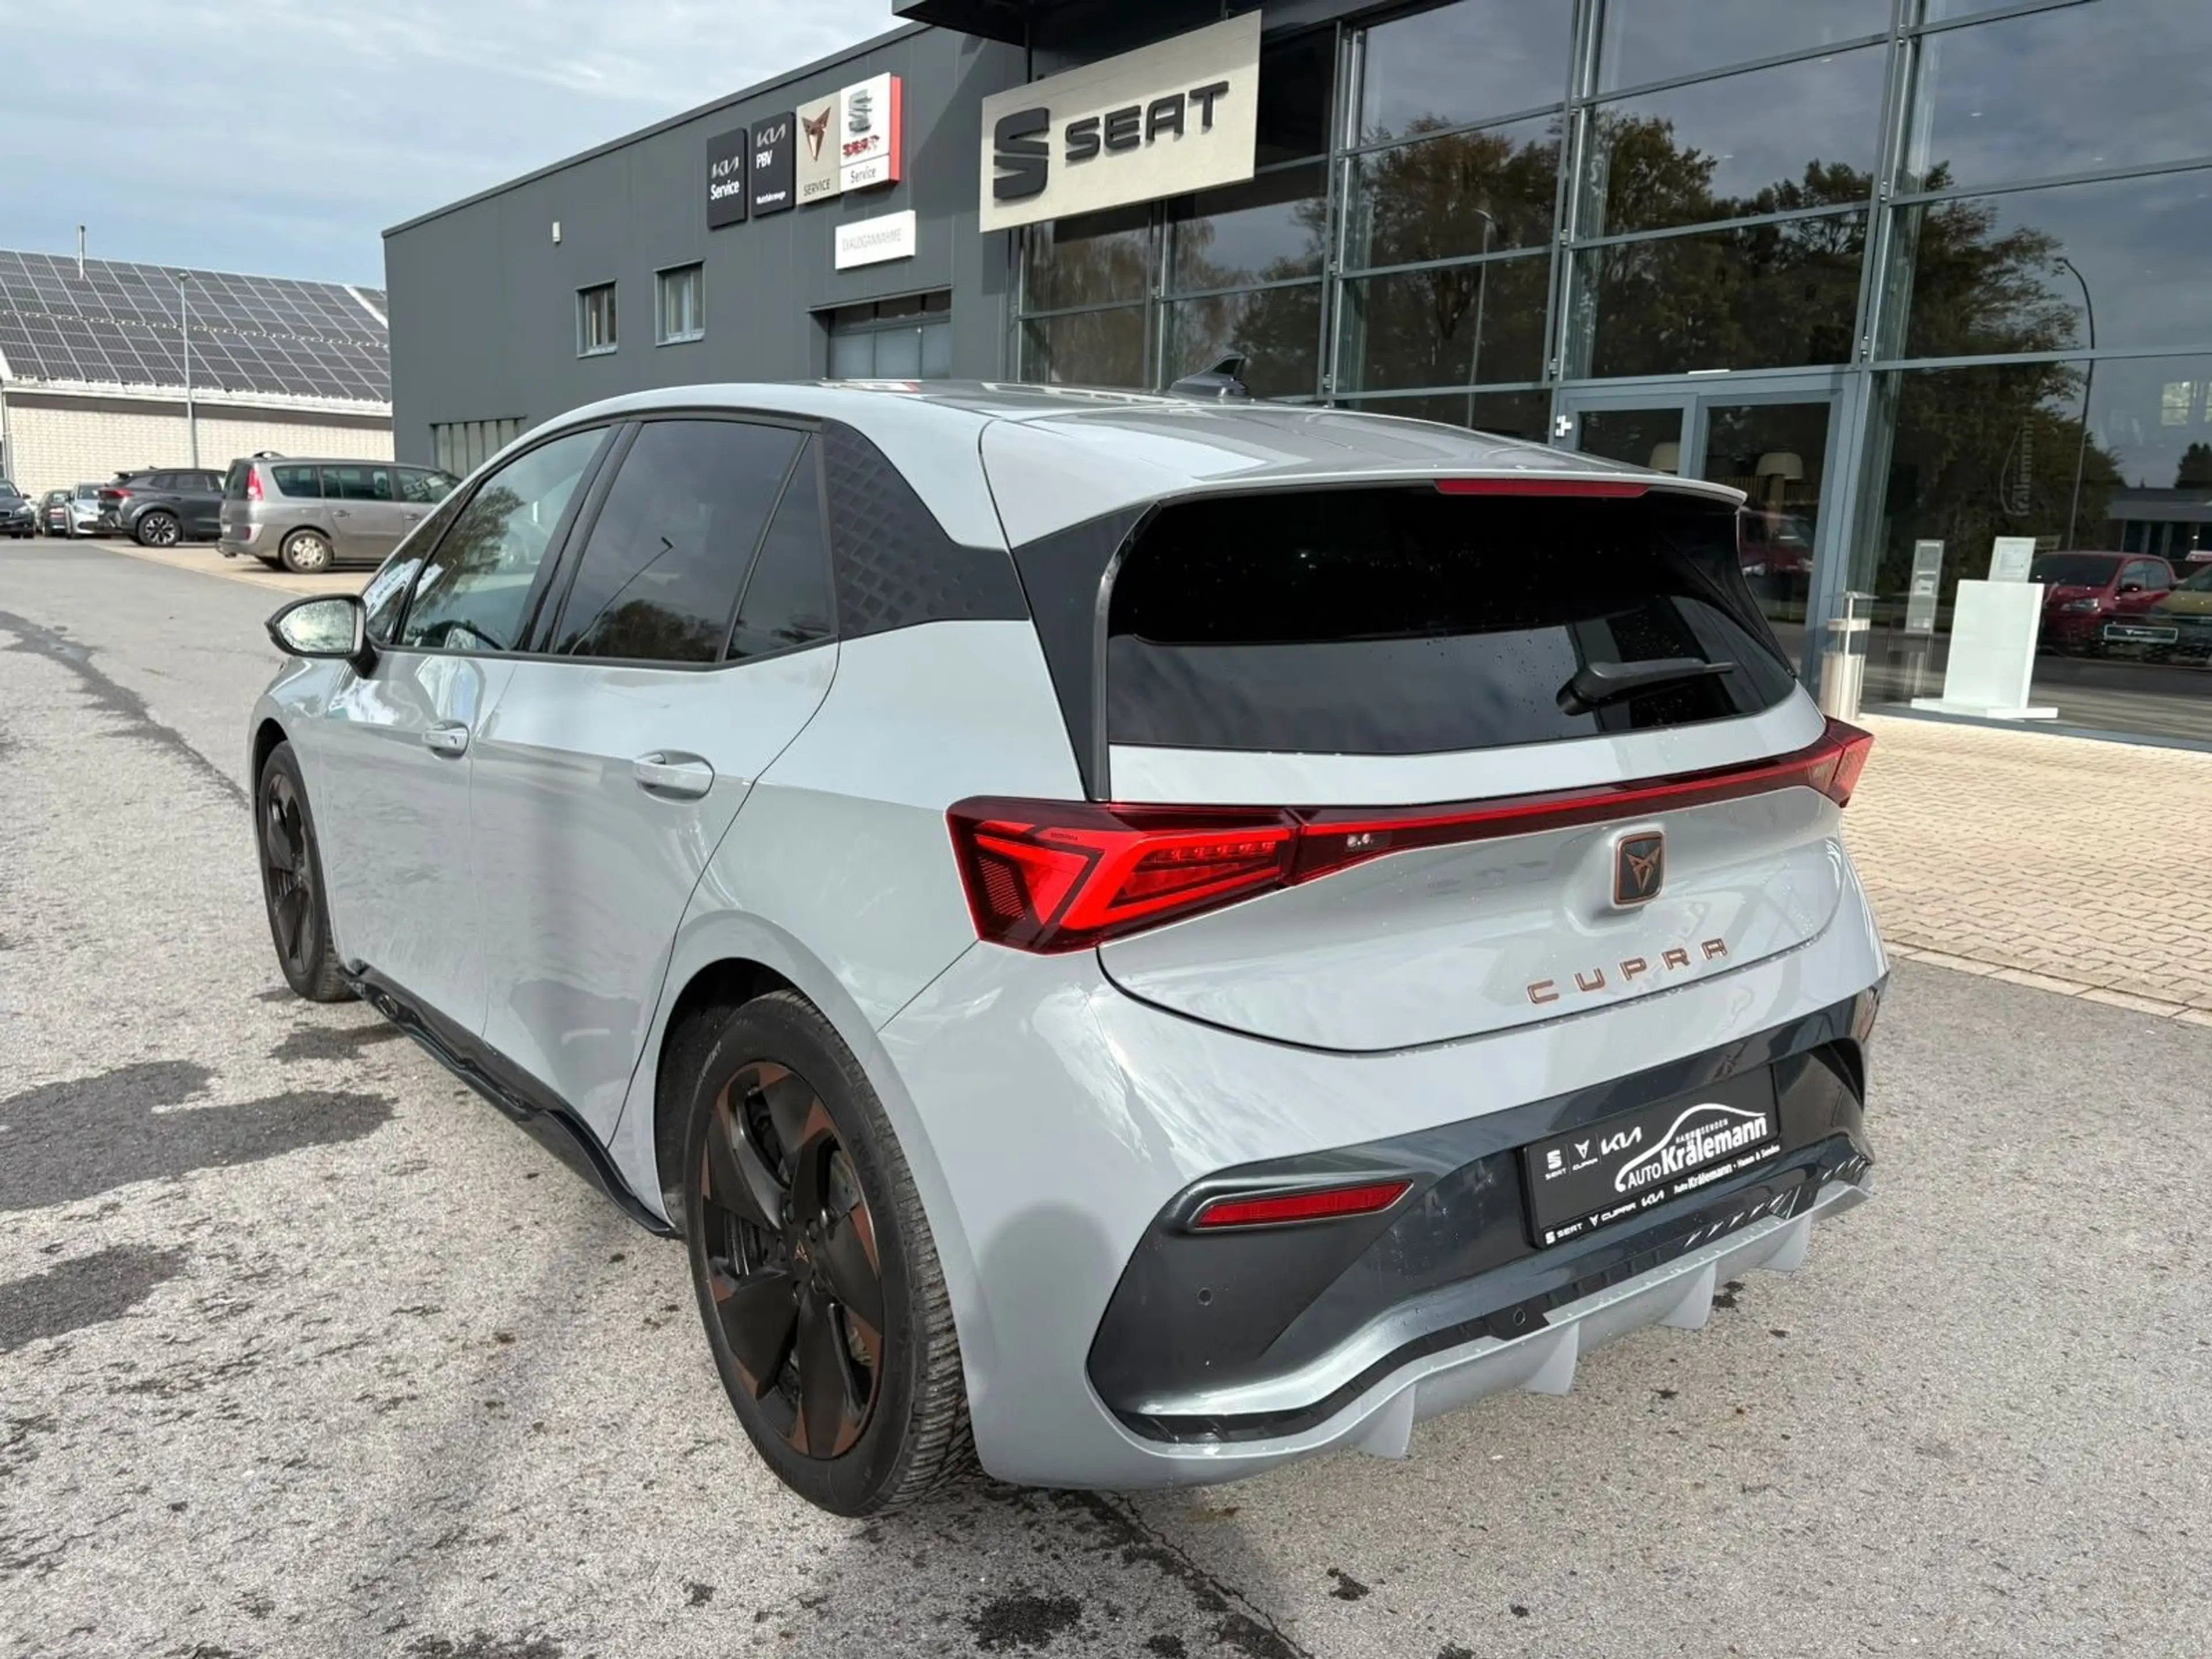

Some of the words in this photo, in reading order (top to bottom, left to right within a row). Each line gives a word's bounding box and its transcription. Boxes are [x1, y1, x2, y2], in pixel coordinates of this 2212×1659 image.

[1065, 81, 1229, 161] SEAT
[756, 149, 773, 169] PBV
[850, 166, 876, 184] Service
[710, 179, 740, 200] Service
[803, 178, 831, 197] SERVICE
[1527, 938, 1728, 1005] CUPRA
[1627, 1162, 1662, 1190] AUTO
[1660, 1116, 1767, 1175] Krälemann
[1545, 1167, 1567, 1180] SEAT
[1556, 1222, 1583, 1238] SEAT
